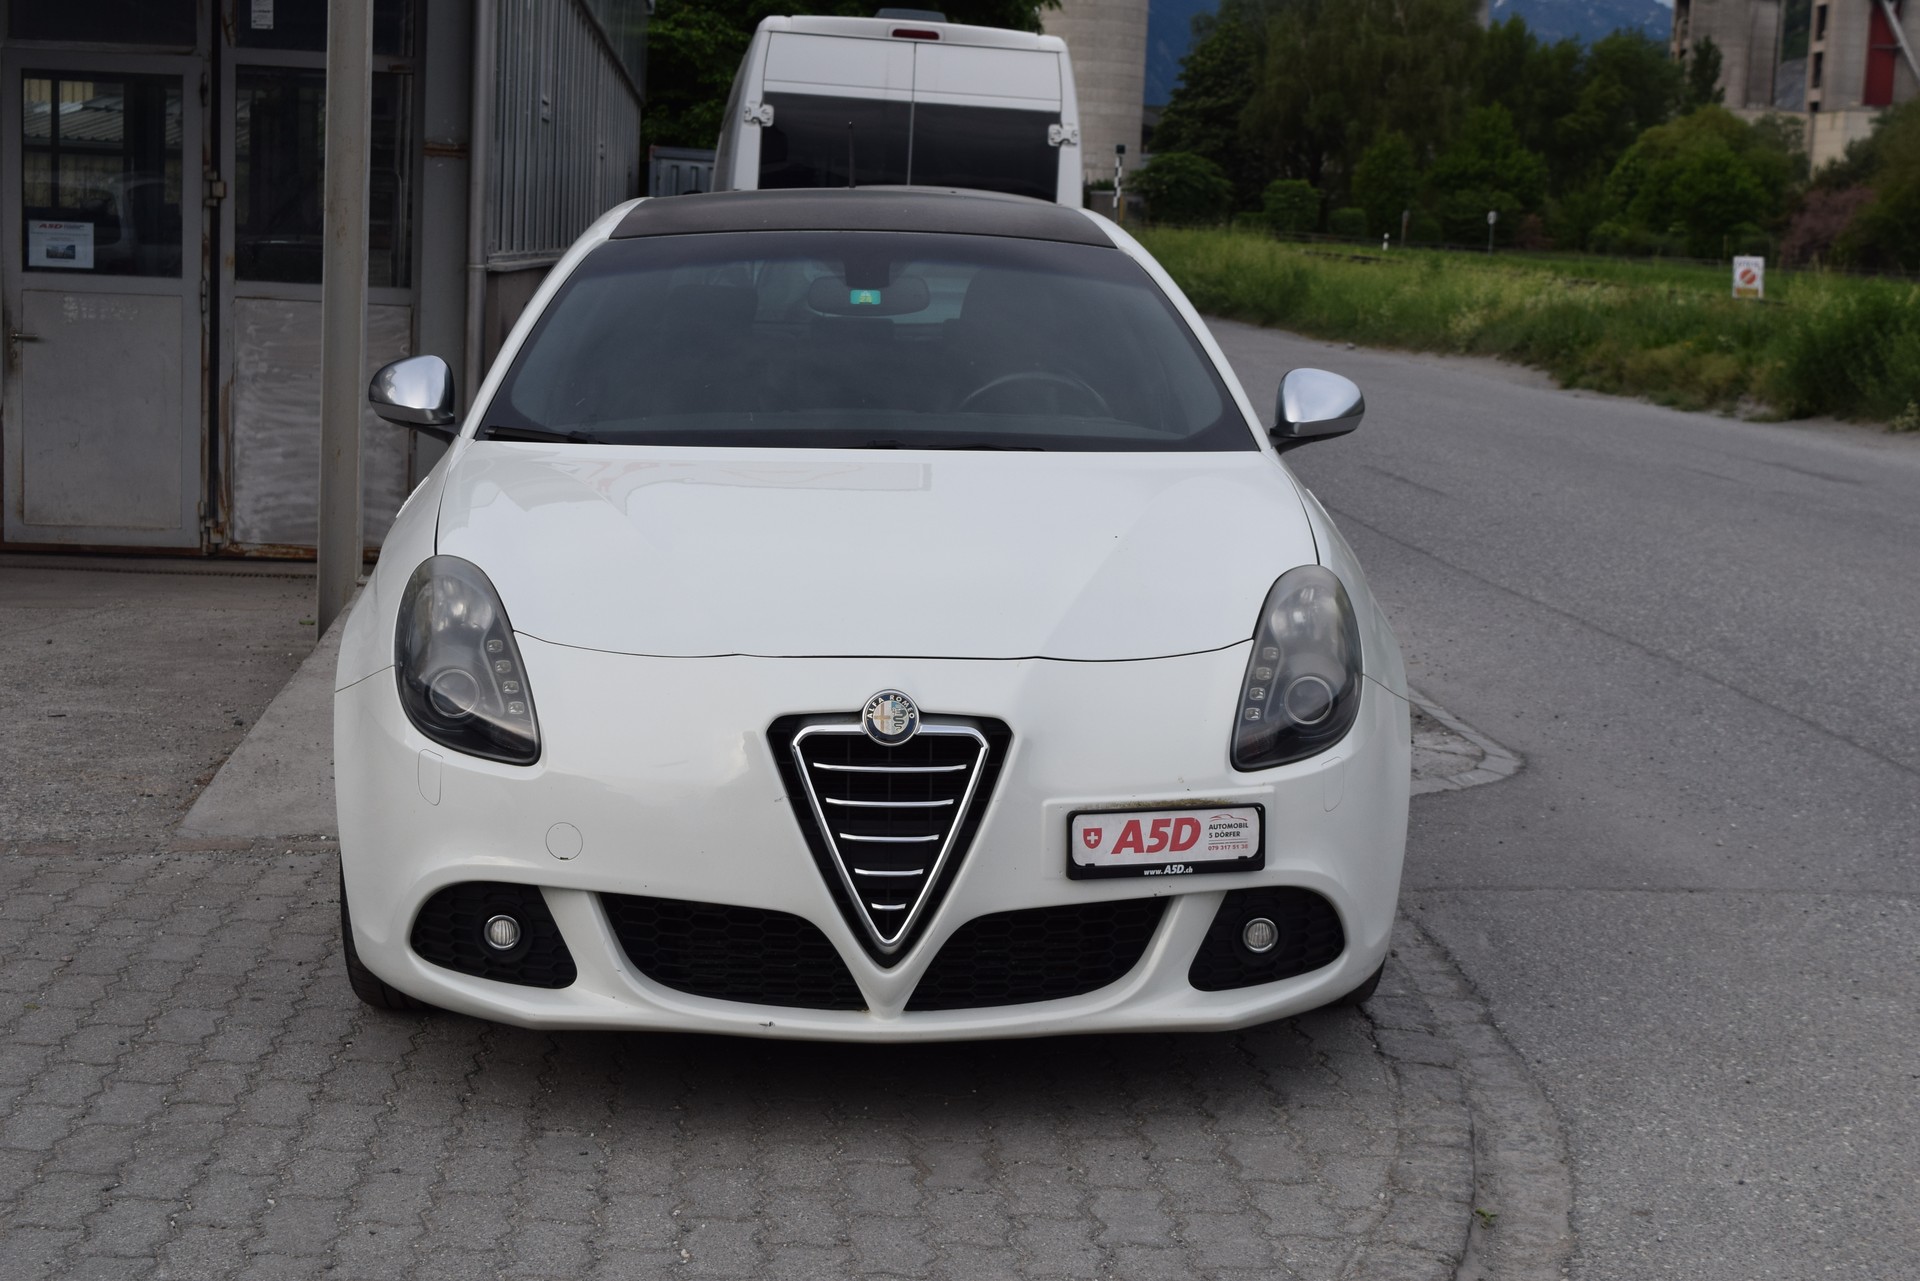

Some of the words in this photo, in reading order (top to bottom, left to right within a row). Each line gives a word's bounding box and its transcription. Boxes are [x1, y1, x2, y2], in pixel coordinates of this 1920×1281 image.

[866, 697, 884, 719] ALFA
[890, 695, 915, 719] ROMEO
[1111, 817, 1201, 855] A5D
[1143, 864, 1193, 876] www.A5D.ch
